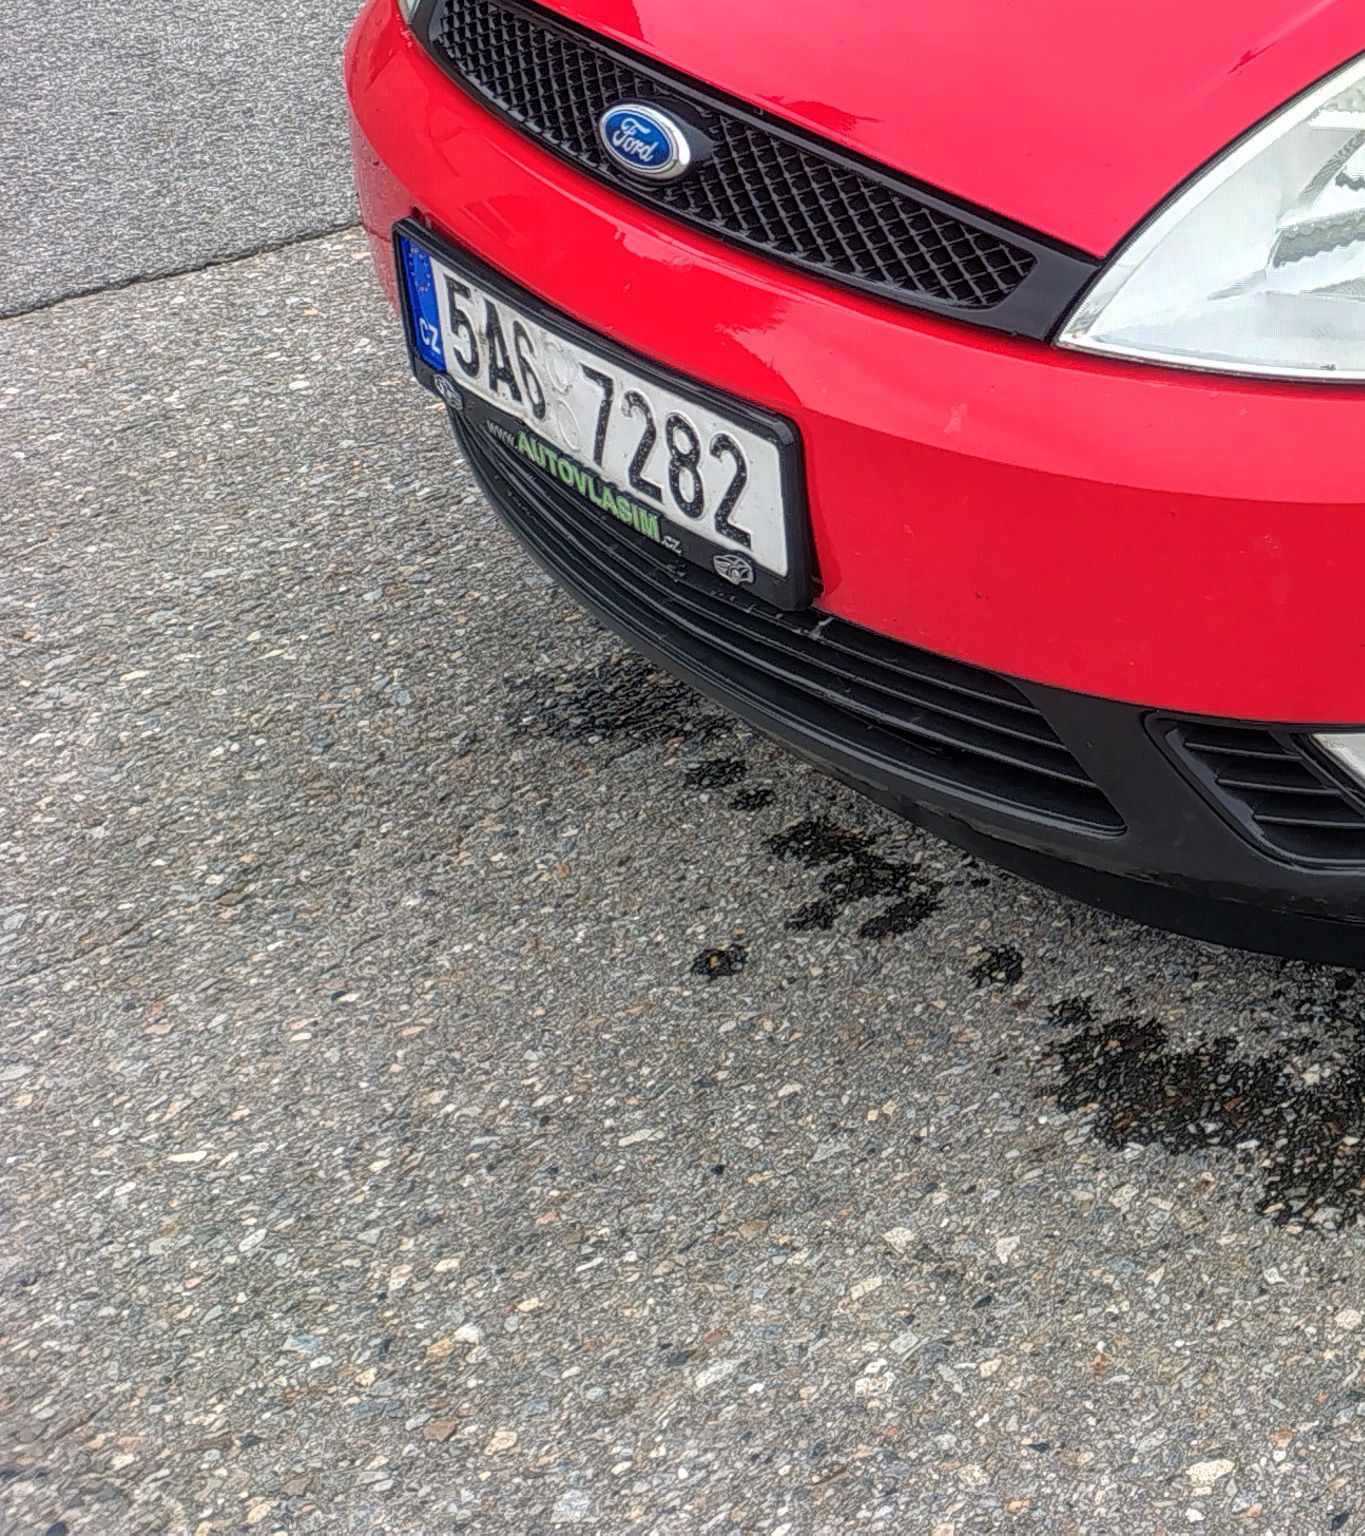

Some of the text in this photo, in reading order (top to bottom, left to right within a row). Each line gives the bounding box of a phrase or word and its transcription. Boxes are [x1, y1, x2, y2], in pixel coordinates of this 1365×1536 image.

[612, 117, 659, 162] Ford
[419, 317, 441, 355] CZ
[443, 272, 753, 550] 5A6 7282
